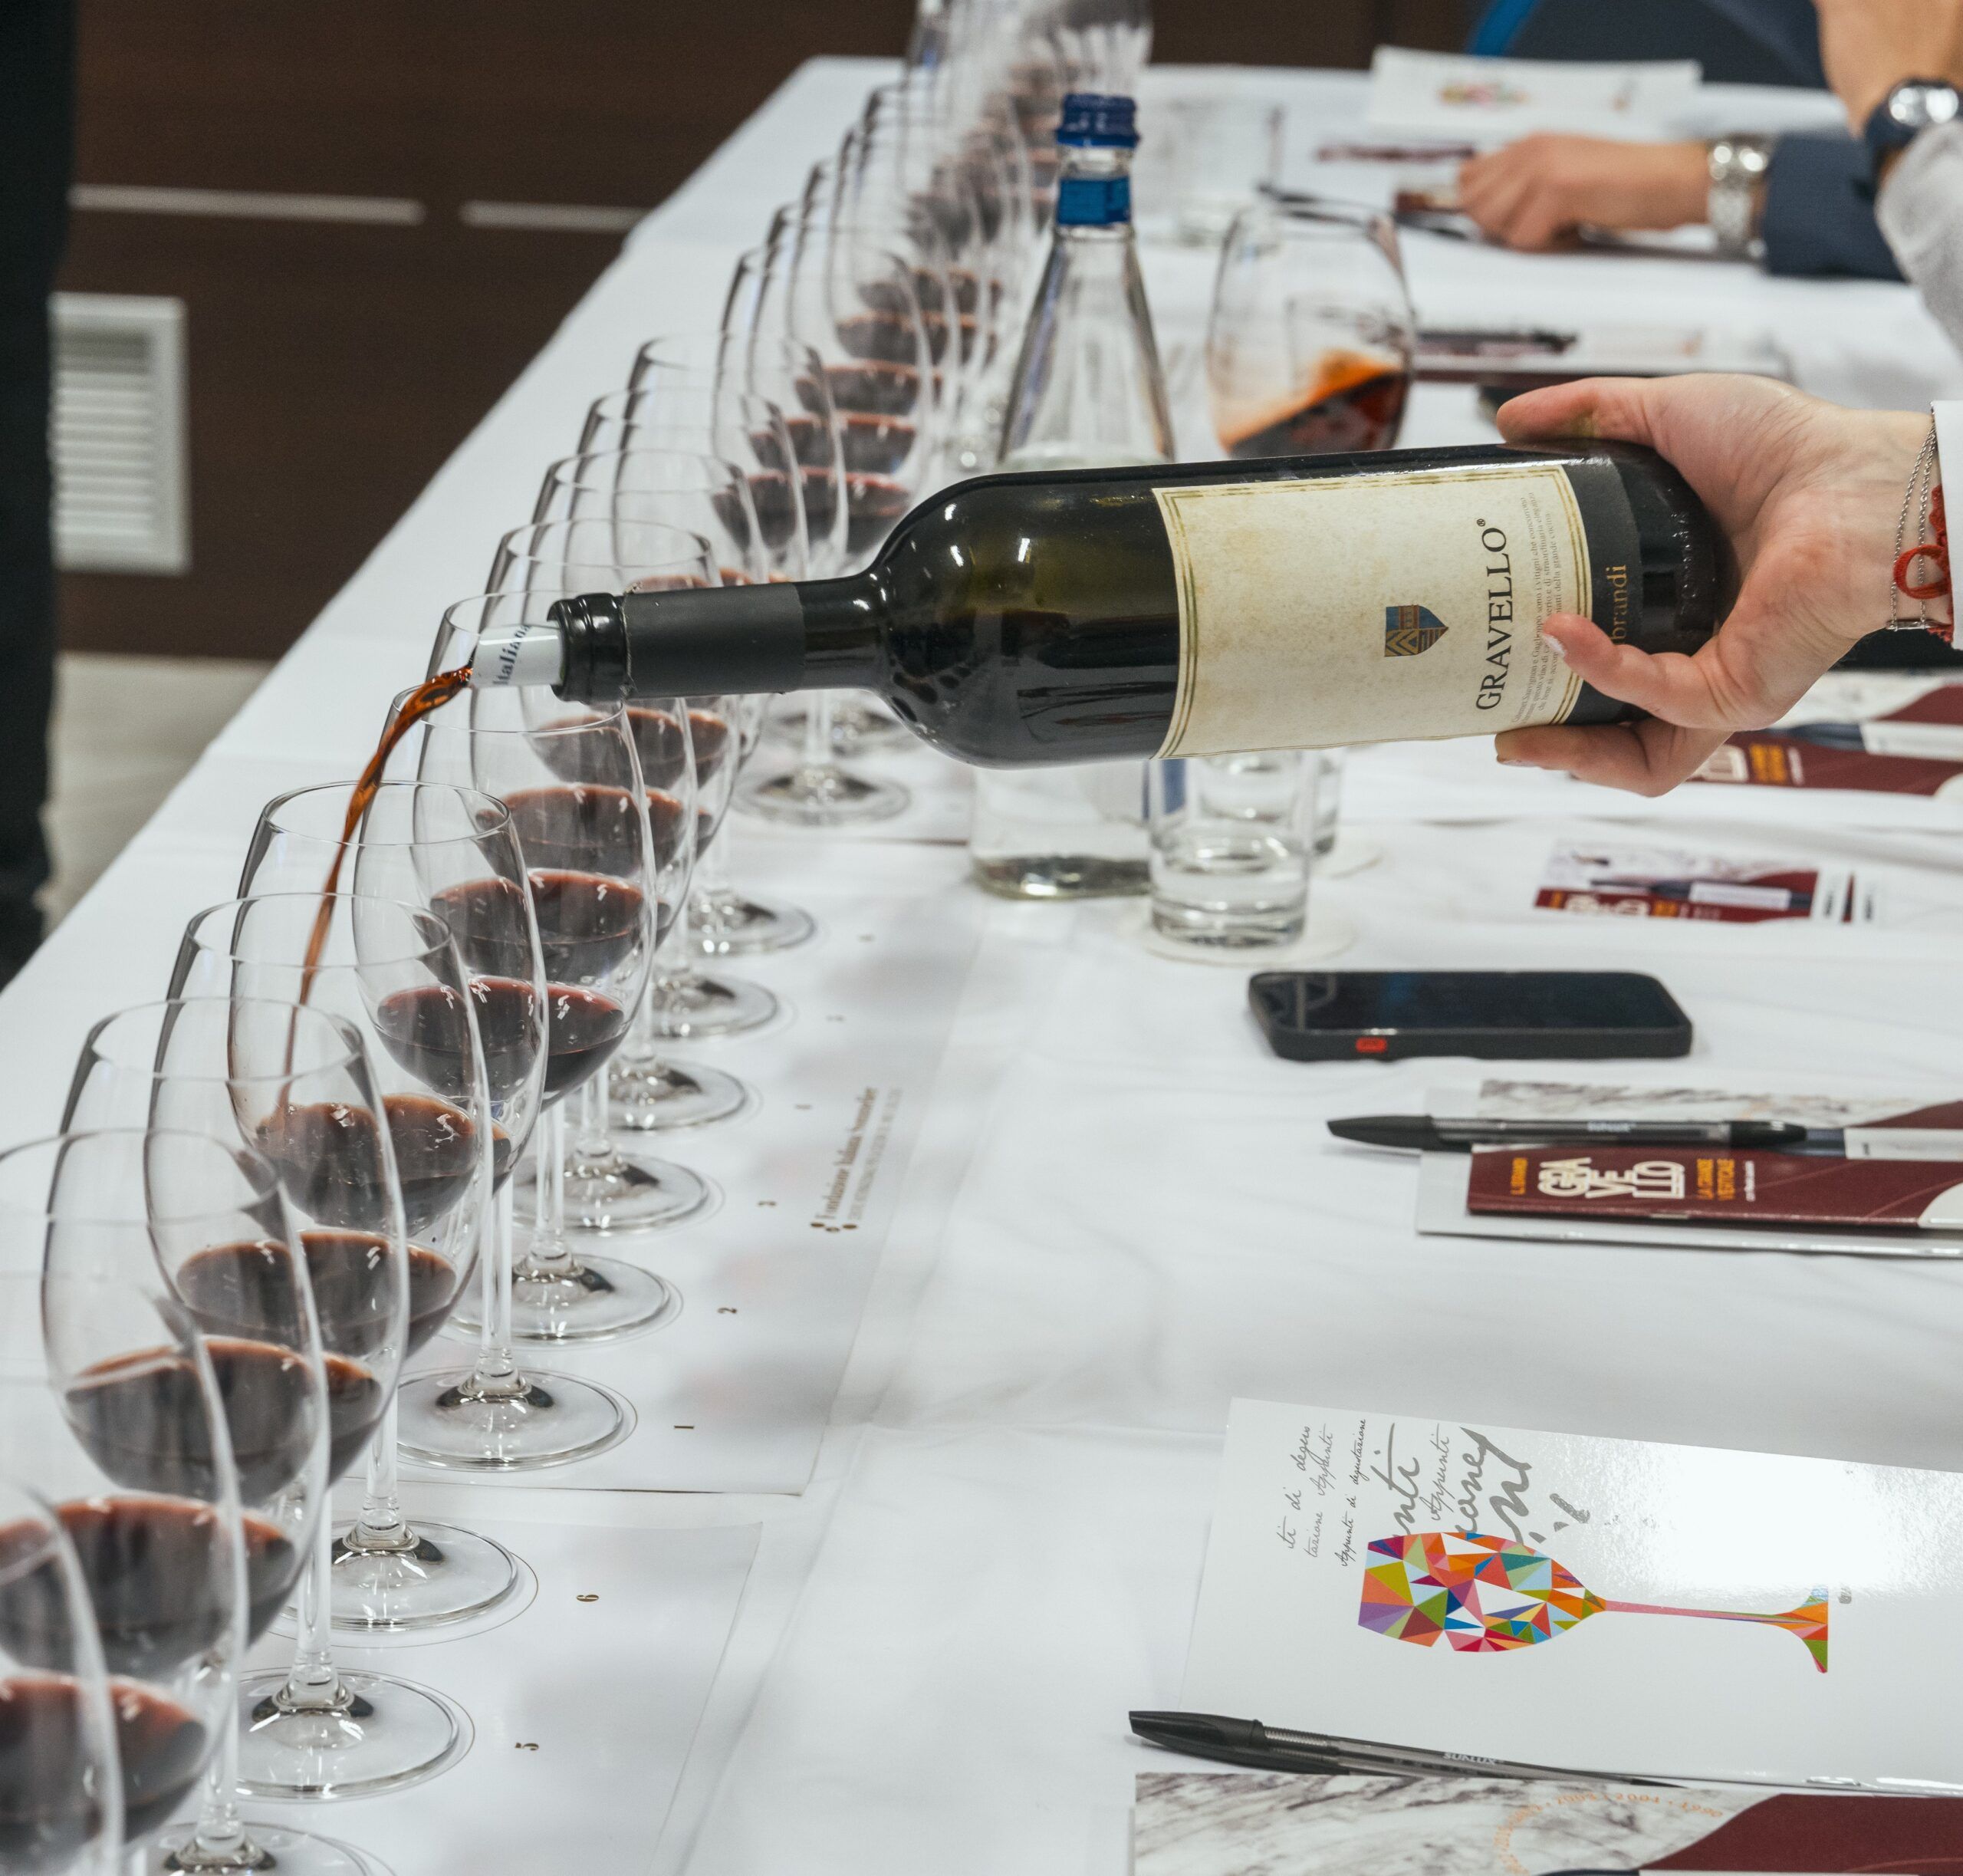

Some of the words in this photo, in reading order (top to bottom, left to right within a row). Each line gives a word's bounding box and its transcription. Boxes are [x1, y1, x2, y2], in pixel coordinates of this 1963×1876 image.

[1520, 497, 1535, 539] concorrono
[1528, 492, 1542, 523] eleganza
[1531, 541, 1539, 556] che
[1537, 525, 1551, 576] straordinaria
[1550, 541, 1563, 568] grande
[1533, 558, 1544, 585] vitigni
[1543, 578, 1552, 587] di
[1552, 571, 1562, 592] della
[1606, 564, 1627, 640] brandi
[1310, 1423, 1337, 1496] Appunti
[1350, 1419, 1369, 1485] degustazione
[1419, 1423, 1455, 1520] Appunti
[1283, 1487, 1301, 1510] di
[1345, 1493, 1356, 1508] di
[1335, 1511, 1356, 1566] Appunti
